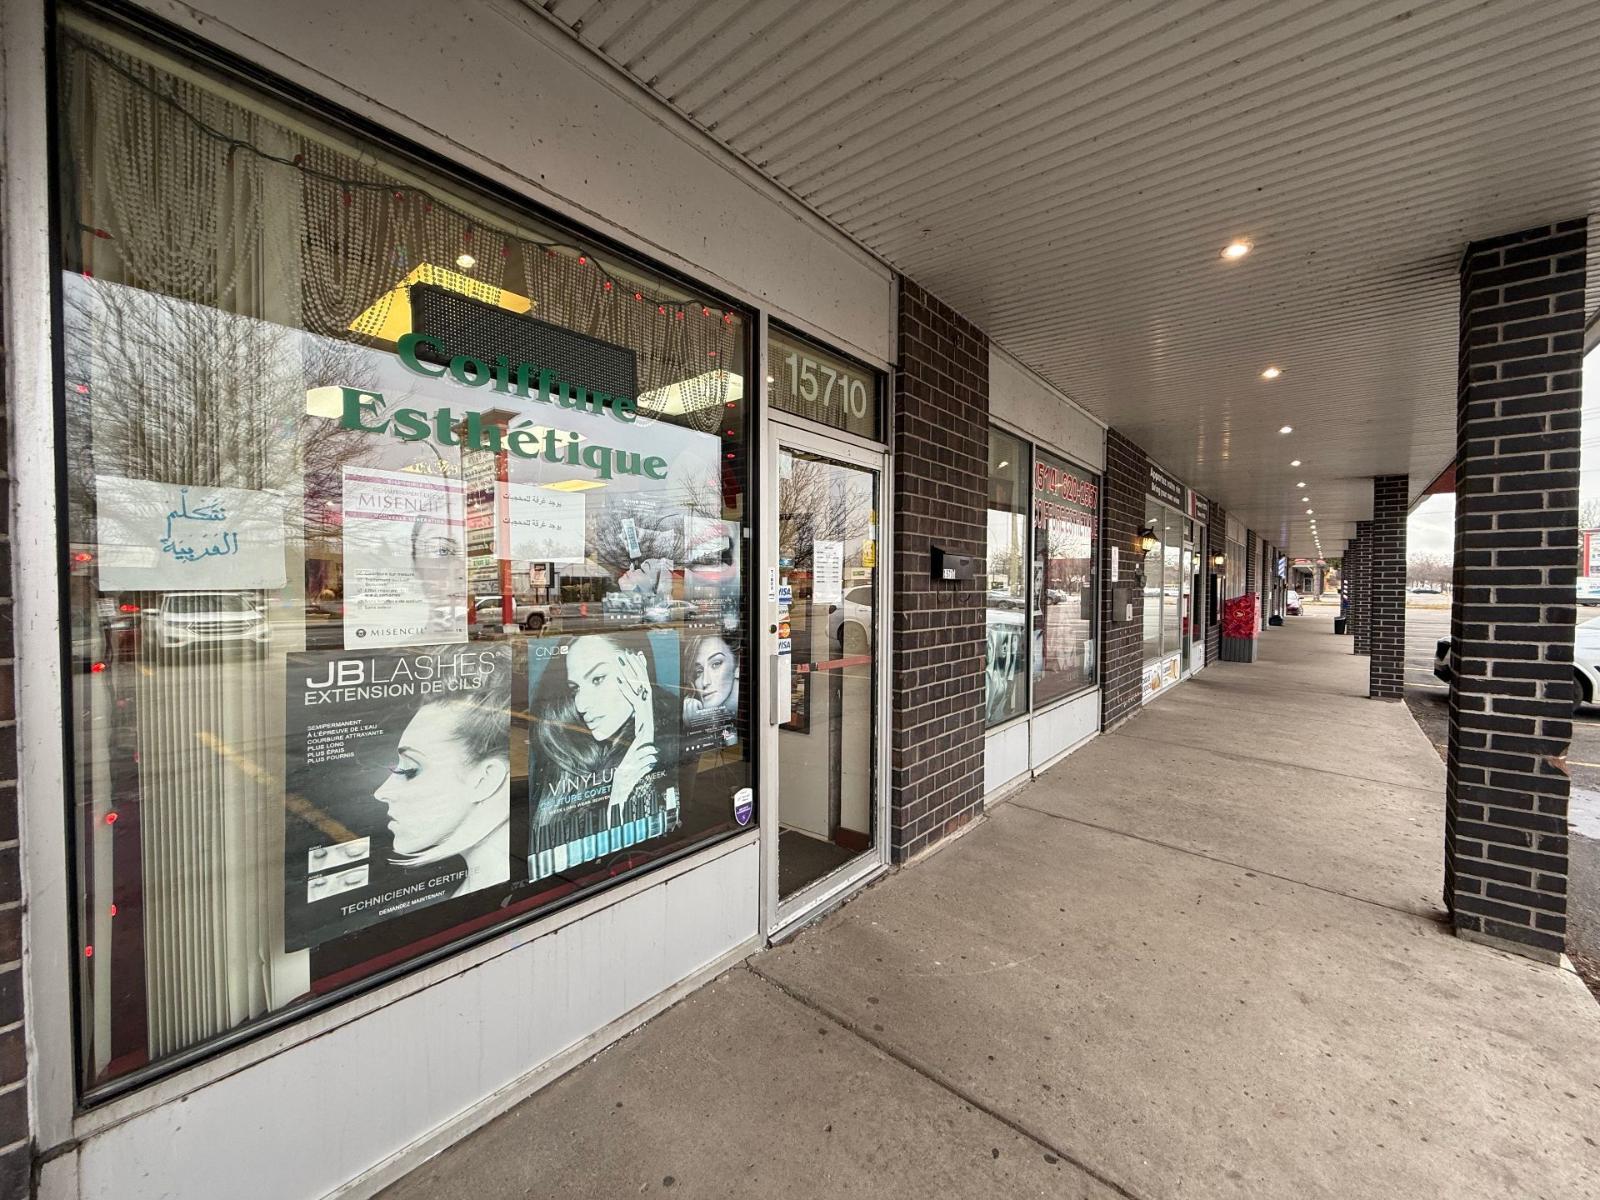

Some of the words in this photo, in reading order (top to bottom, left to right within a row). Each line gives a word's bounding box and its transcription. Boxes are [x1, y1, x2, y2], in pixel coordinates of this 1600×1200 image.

[397, 332, 638, 423] Coiffure
[785, 351, 868, 420] 15710
[341, 386, 668, 480] Esthétique
[306, 660, 365, 689] JB
[304, 684, 415, 706] EXTENSION
[420, 681, 444, 695] DE
[447, 677, 483, 692] CILS
[307, 744, 325, 752] PLUS
[345, 729, 384, 739] ATTRAYANTE
[327, 752, 355, 761] FOURNIS
[549, 767, 617, 797] VINYLU
[341, 882, 426, 917] TECHNICIENNE
[378, 901, 411, 917] DEMANDEZ
[411, 889, 446, 905] MAINTENANT
